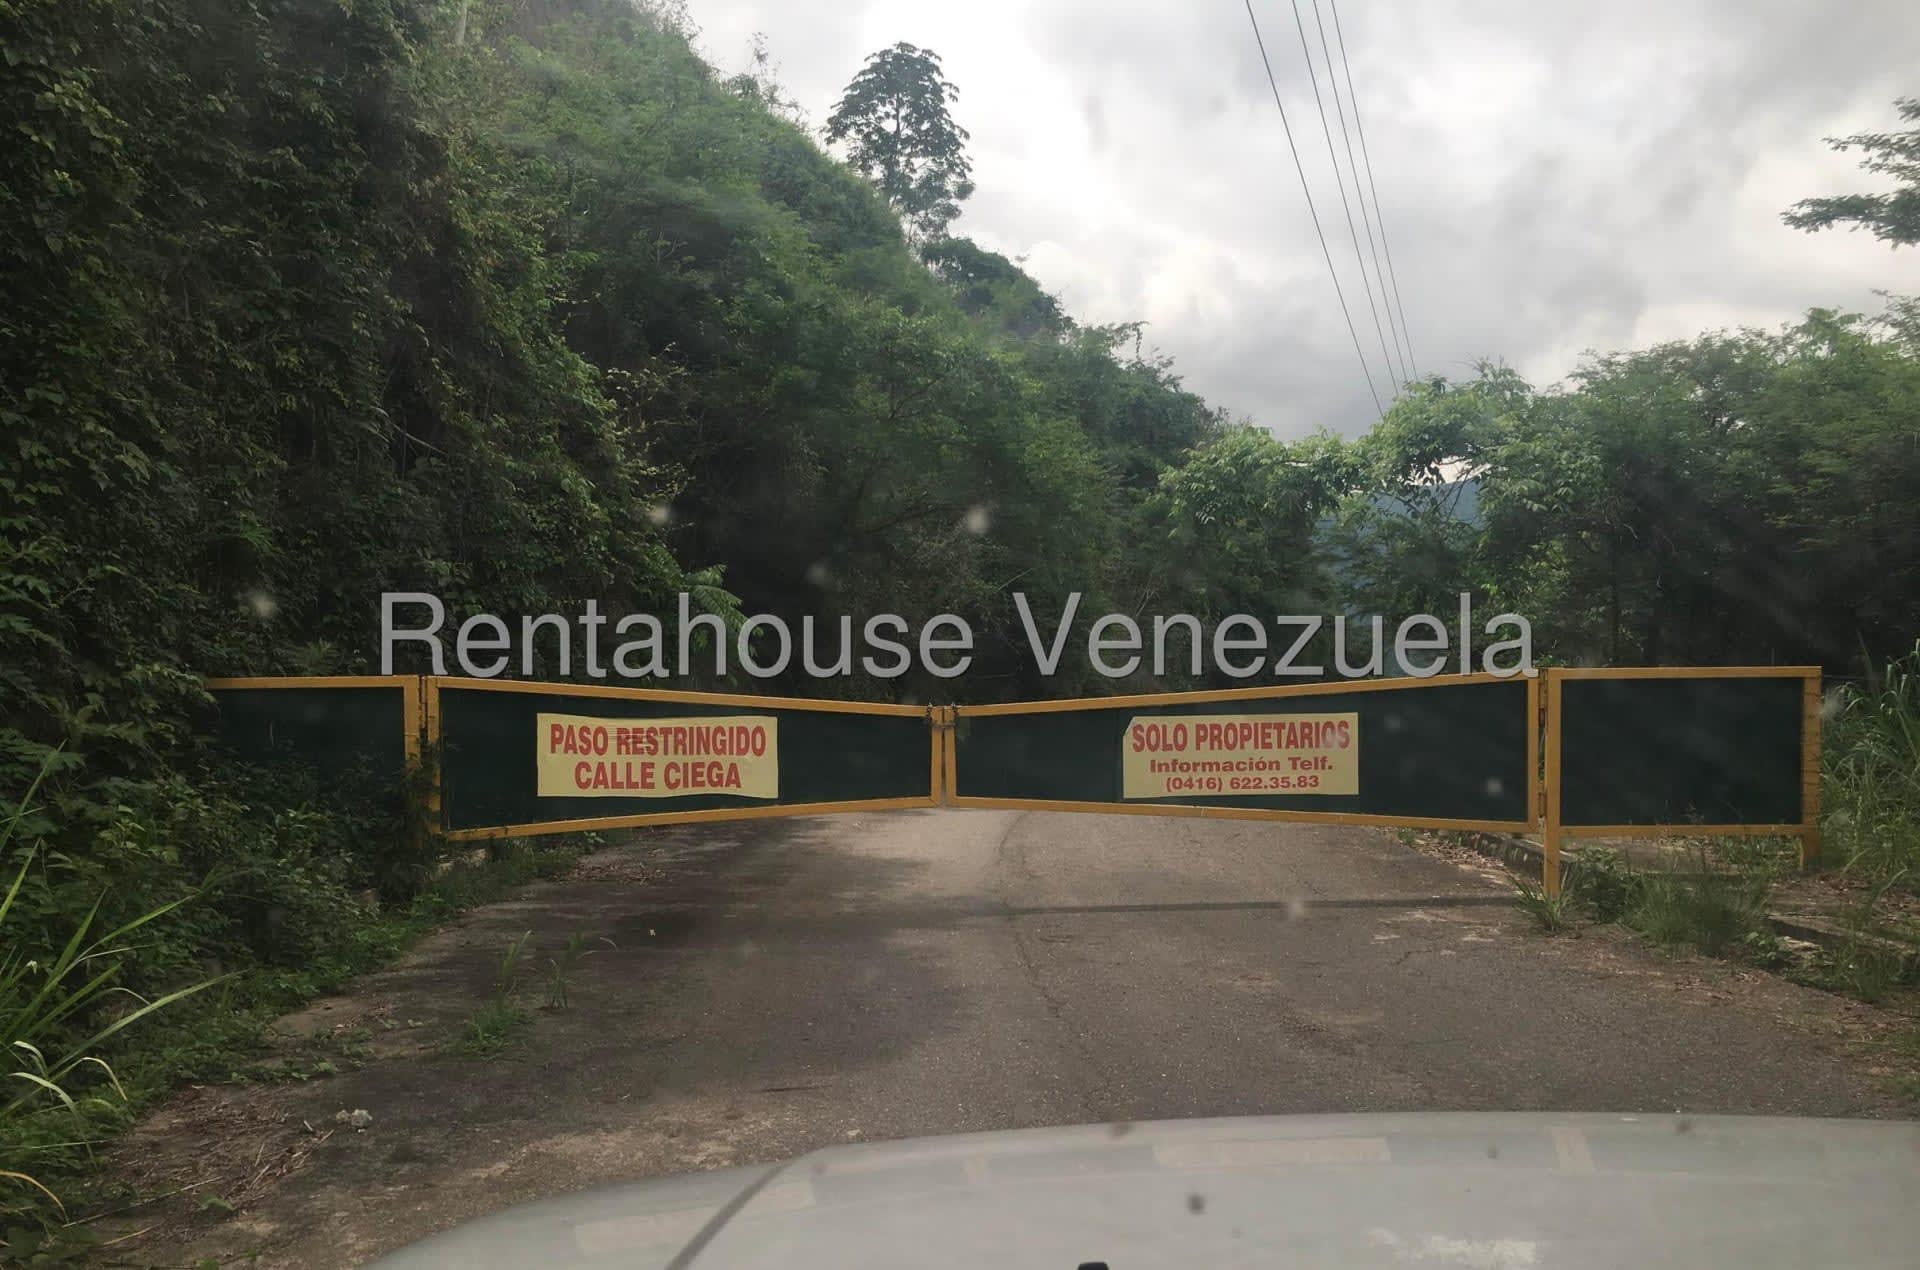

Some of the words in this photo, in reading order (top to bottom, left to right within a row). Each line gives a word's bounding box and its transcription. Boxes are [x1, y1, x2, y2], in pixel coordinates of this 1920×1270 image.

[550, 724, 609, 756] PASO
[616, 726, 766, 757] RESTRINGIDO
[1132, 724, 1188, 752] SOLO
[1194, 720, 1350, 752] PROPIETARIOS
[574, 762, 655, 790] CALLE
[664, 762, 742, 790] CIEGA
[1150, 756, 1281, 773] Información
[1288, 755, 1333, 772] Telf.
[1166, 776, 1223, 793] (0416)
[1229, 774, 1320, 791] 622.35.83
